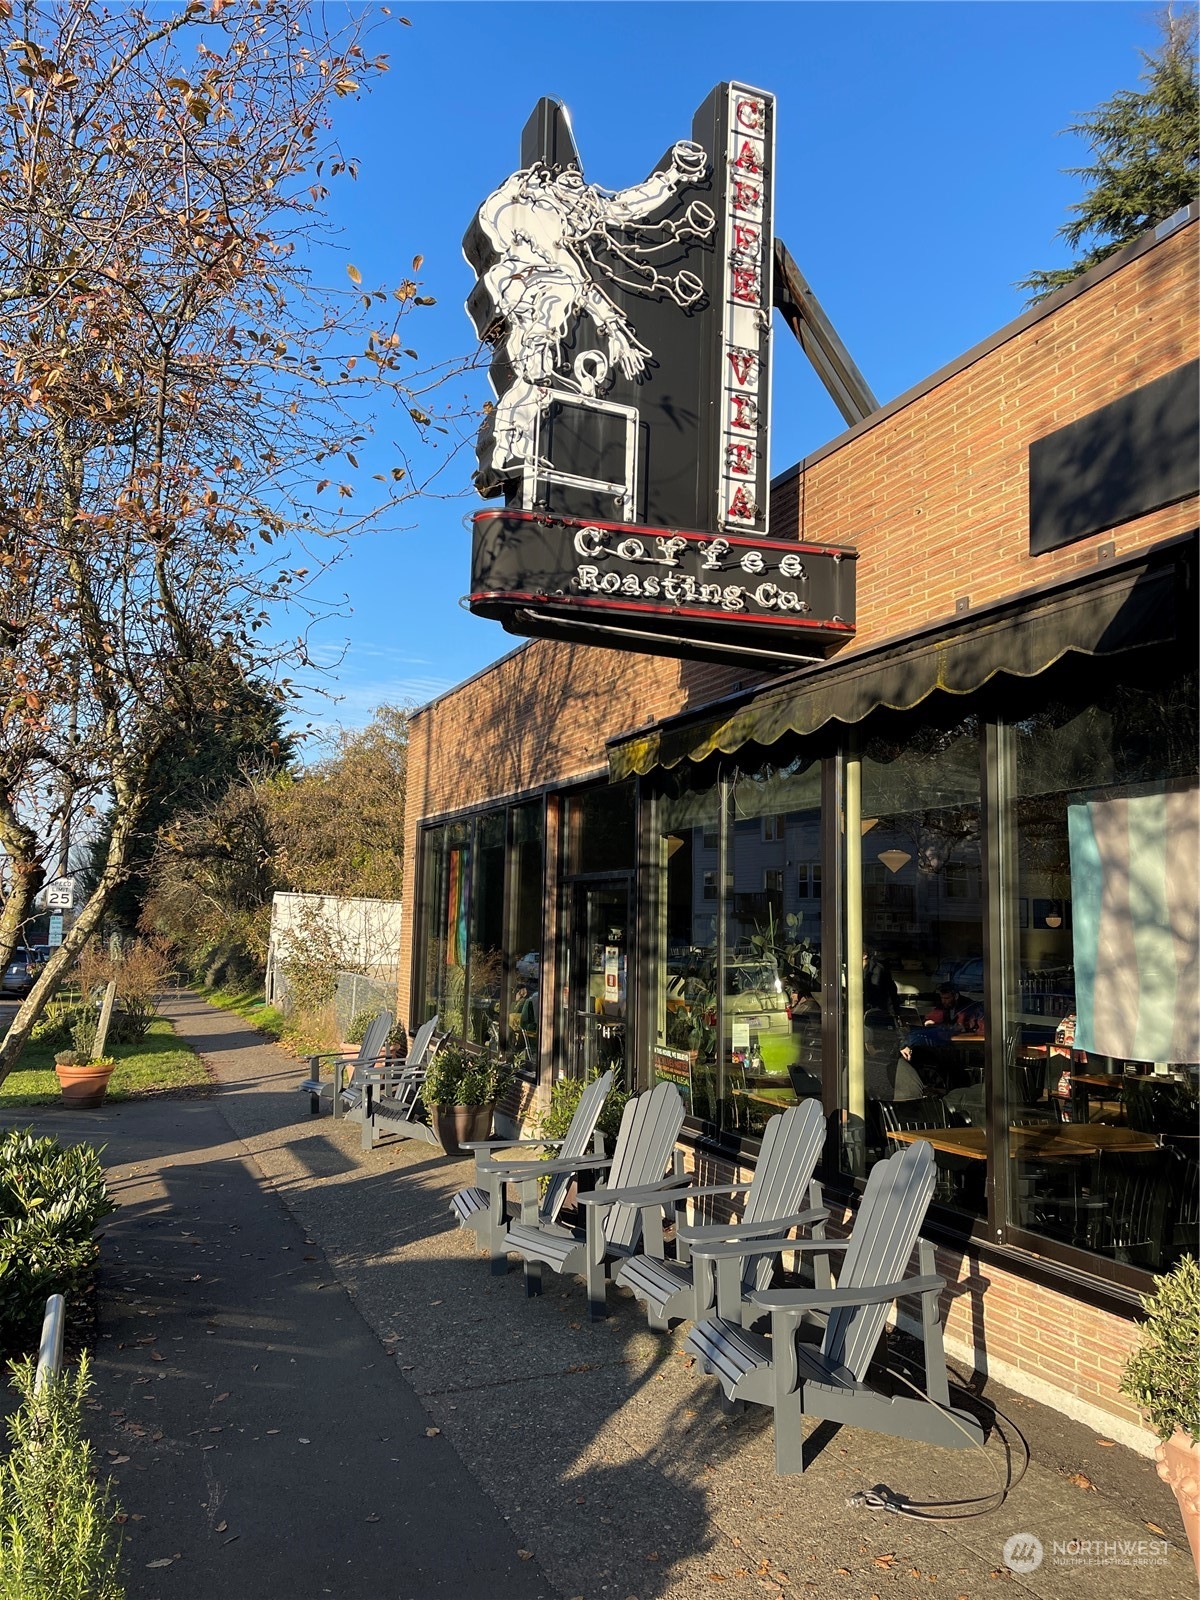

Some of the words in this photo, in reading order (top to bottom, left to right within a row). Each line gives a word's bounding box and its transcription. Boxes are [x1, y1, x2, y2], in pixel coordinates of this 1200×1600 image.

[727, 347, 759, 520] VITA
[573, 526, 804, 578] Coffee
[576, 564, 745, 610] Roasting
[49, 893, 69, 904] 25
